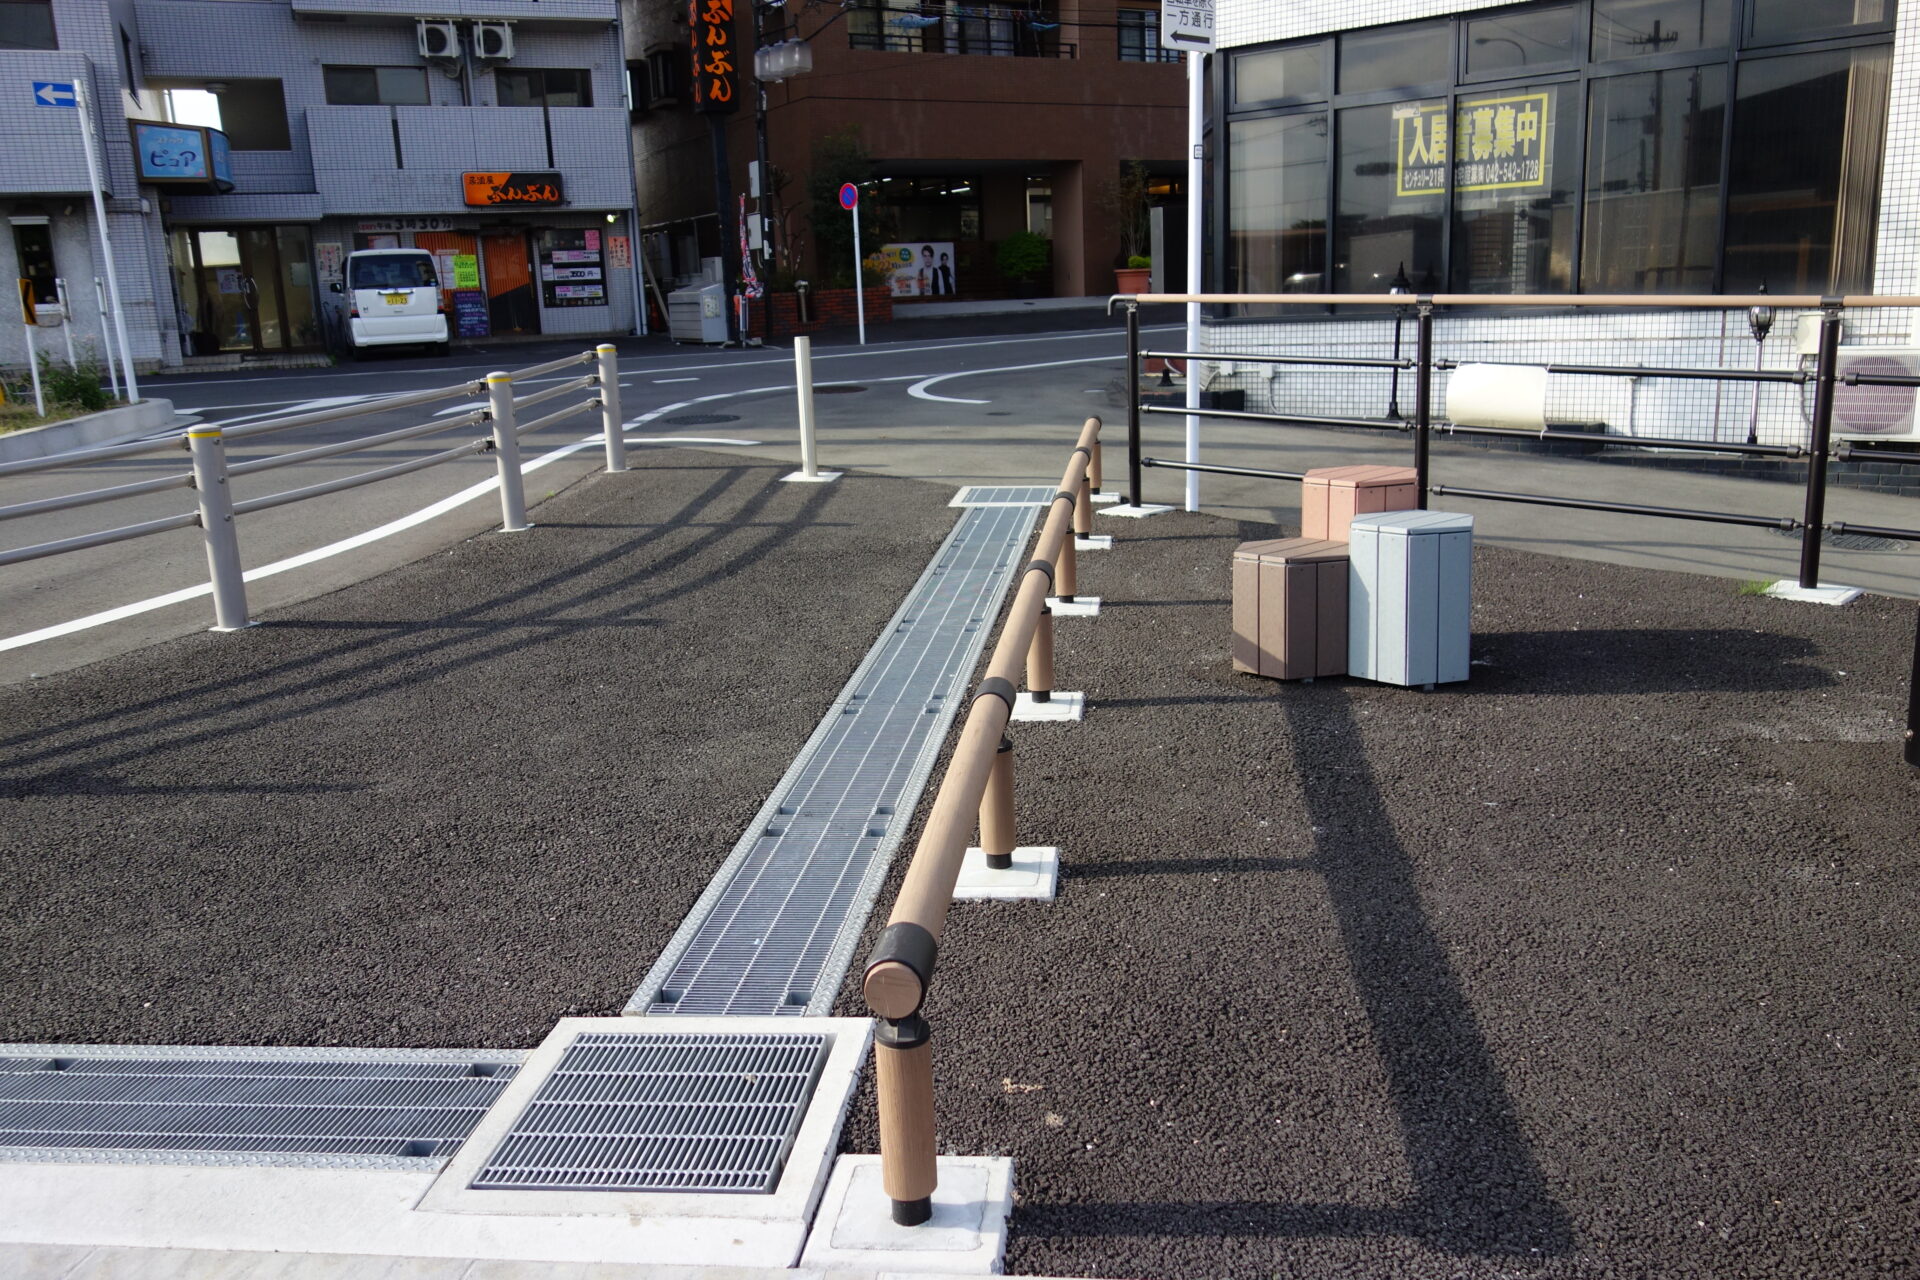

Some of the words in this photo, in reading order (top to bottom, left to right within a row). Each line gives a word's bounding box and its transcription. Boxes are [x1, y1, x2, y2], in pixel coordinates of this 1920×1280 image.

[1167, 10, 1213, 29] 一方通行
[1408, 103, 1538, 166] 入居者募集中
[150, 149, 196, 168] ピュア
[1485, 159, 1540, 184] 042-542-1728
[487, 184, 559, 203] ぶんぶん
